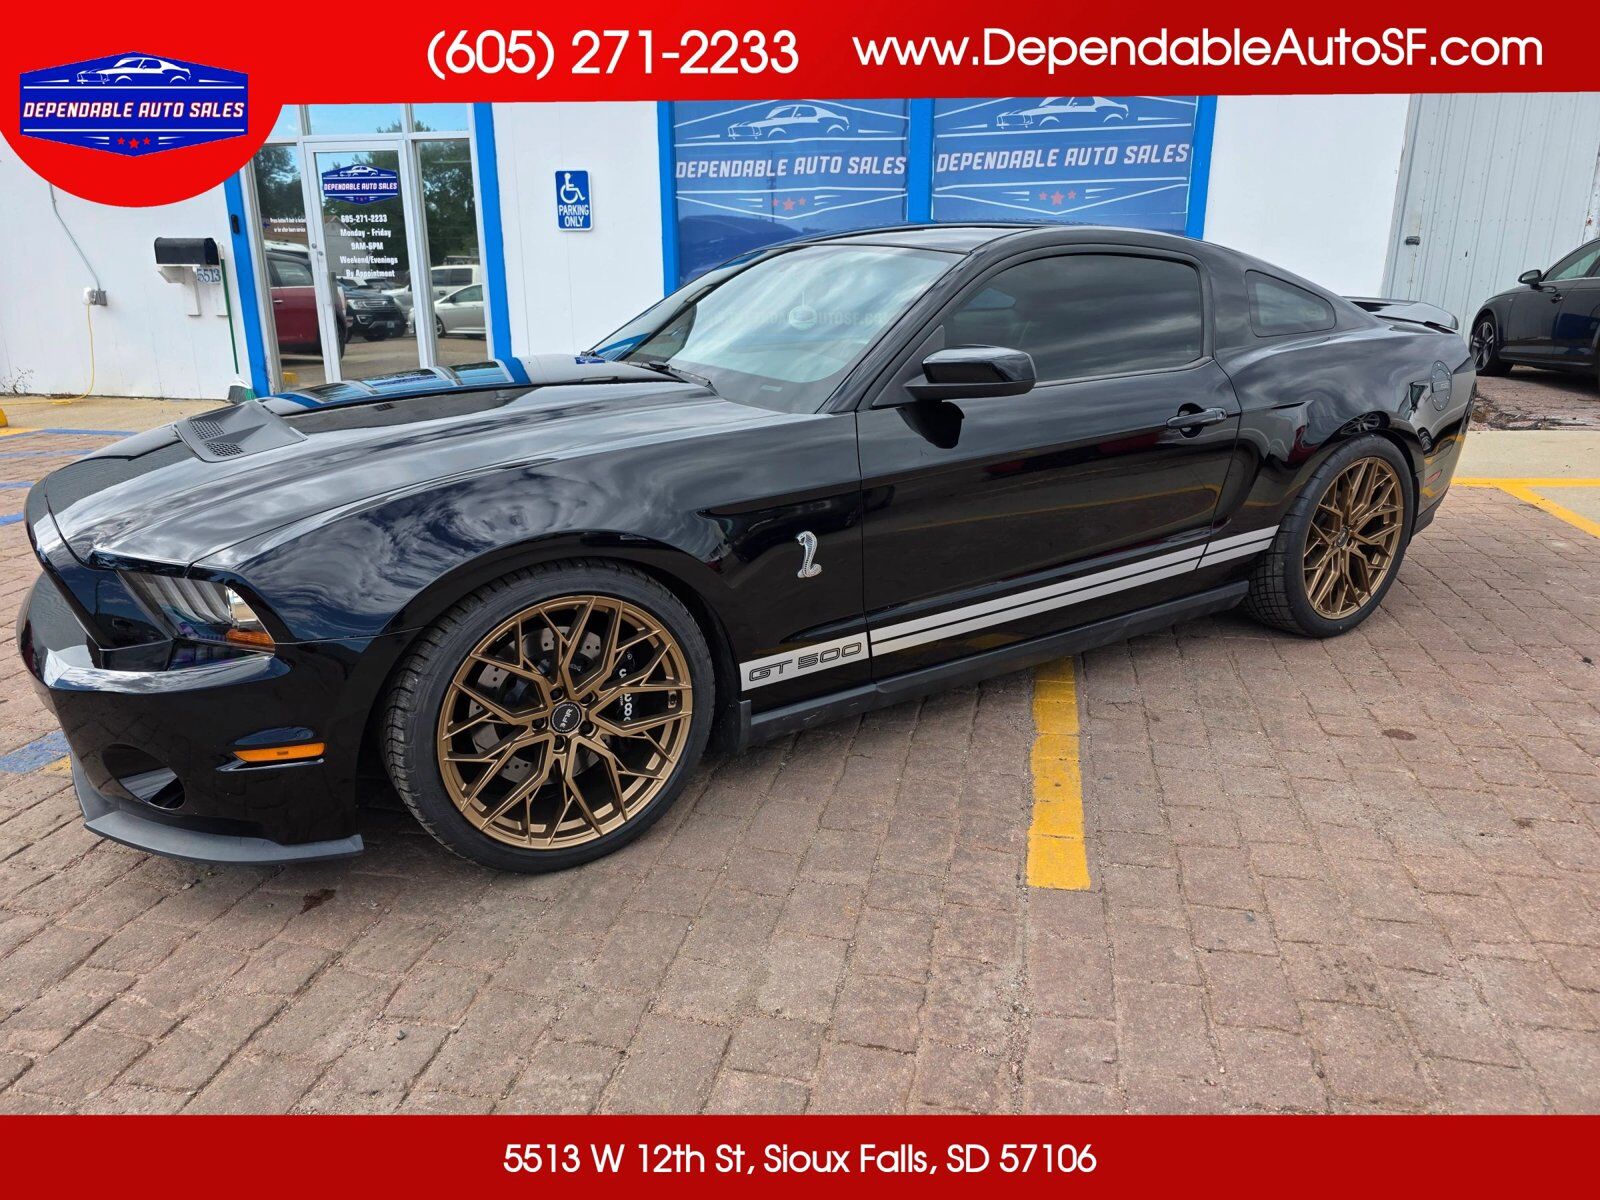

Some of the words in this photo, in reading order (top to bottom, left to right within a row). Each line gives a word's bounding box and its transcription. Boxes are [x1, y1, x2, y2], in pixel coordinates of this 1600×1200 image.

[936, 149, 1059, 173] DEPENDABLE
[1064, 146, 1118, 167] AUTO
[1123, 144, 1190, 164] SALES
[676, 159, 788, 178] DEPENDABLE
[793, 156, 842, 175] AUTO
[847, 157, 907, 175] SALES
[323, 183, 360, 191] DEPENDABLE
[361, 182, 377, 190] AUTO
[558, 204, 590, 216] PARKING
[564, 215, 585, 227] ONLY
[340, 229, 366, 238] Monday
[371, 228, 392, 238] Friday
[196, 268, 221, 283] 5513
[748, 659, 793, 682] GT
[797, 642, 862, 670] 500
